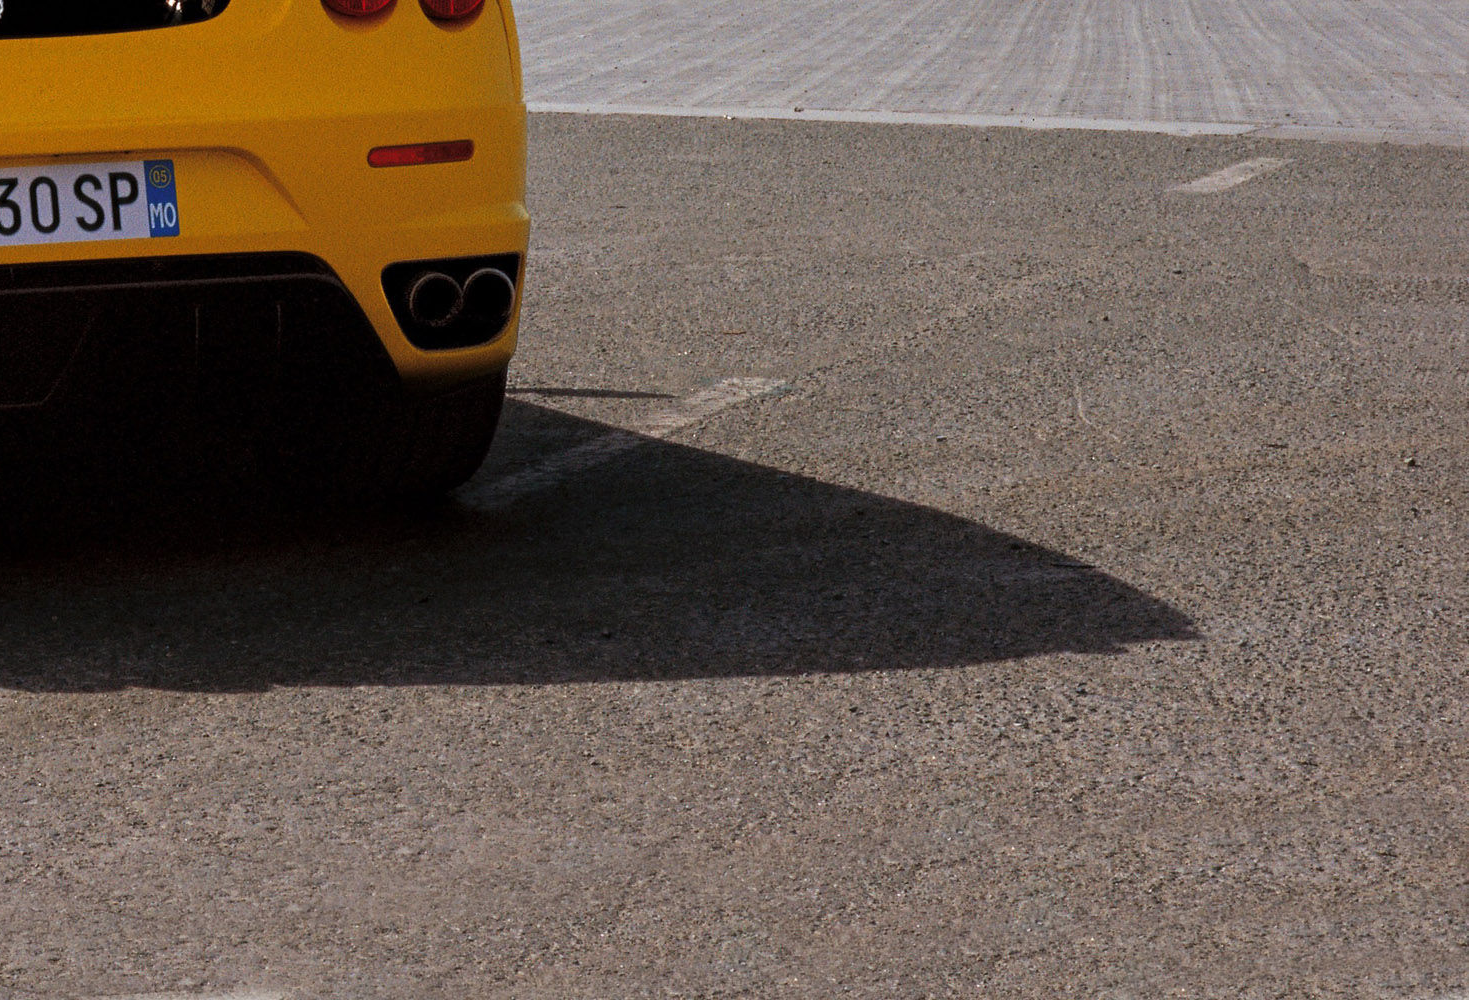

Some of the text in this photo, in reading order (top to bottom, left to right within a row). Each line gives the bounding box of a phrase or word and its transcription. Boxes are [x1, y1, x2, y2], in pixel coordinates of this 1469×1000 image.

[152, 170, 168, 184] 05
[73, 171, 139, 232] SP
[148, 202, 177, 229] MO
